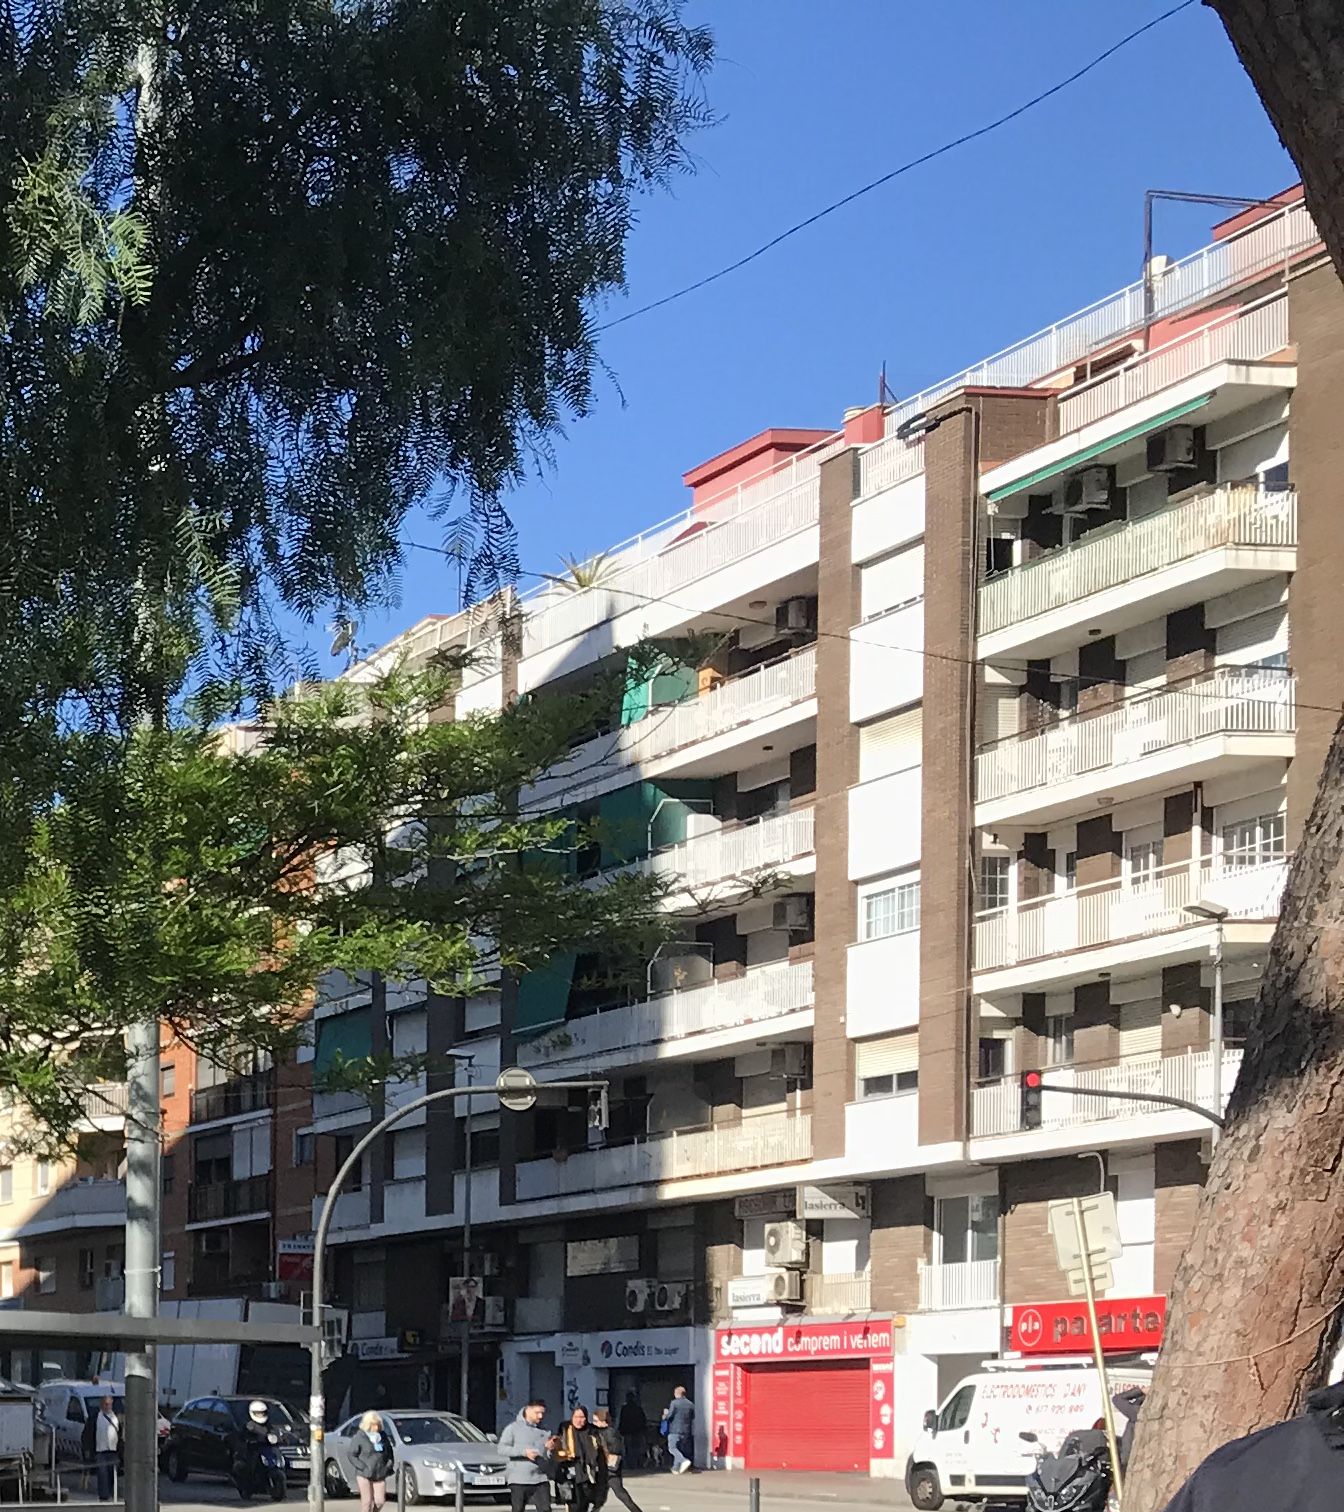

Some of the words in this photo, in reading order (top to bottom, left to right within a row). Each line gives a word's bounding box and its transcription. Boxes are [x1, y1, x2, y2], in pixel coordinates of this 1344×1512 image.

[1053, 1306, 1162, 1344] paarte
[615, 1340, 646, 1358] Condis
[721, 1327, 784, 1357] second
[787, 1334, 840, 1355] comprem
[843, 1331, 848, 1349] i
